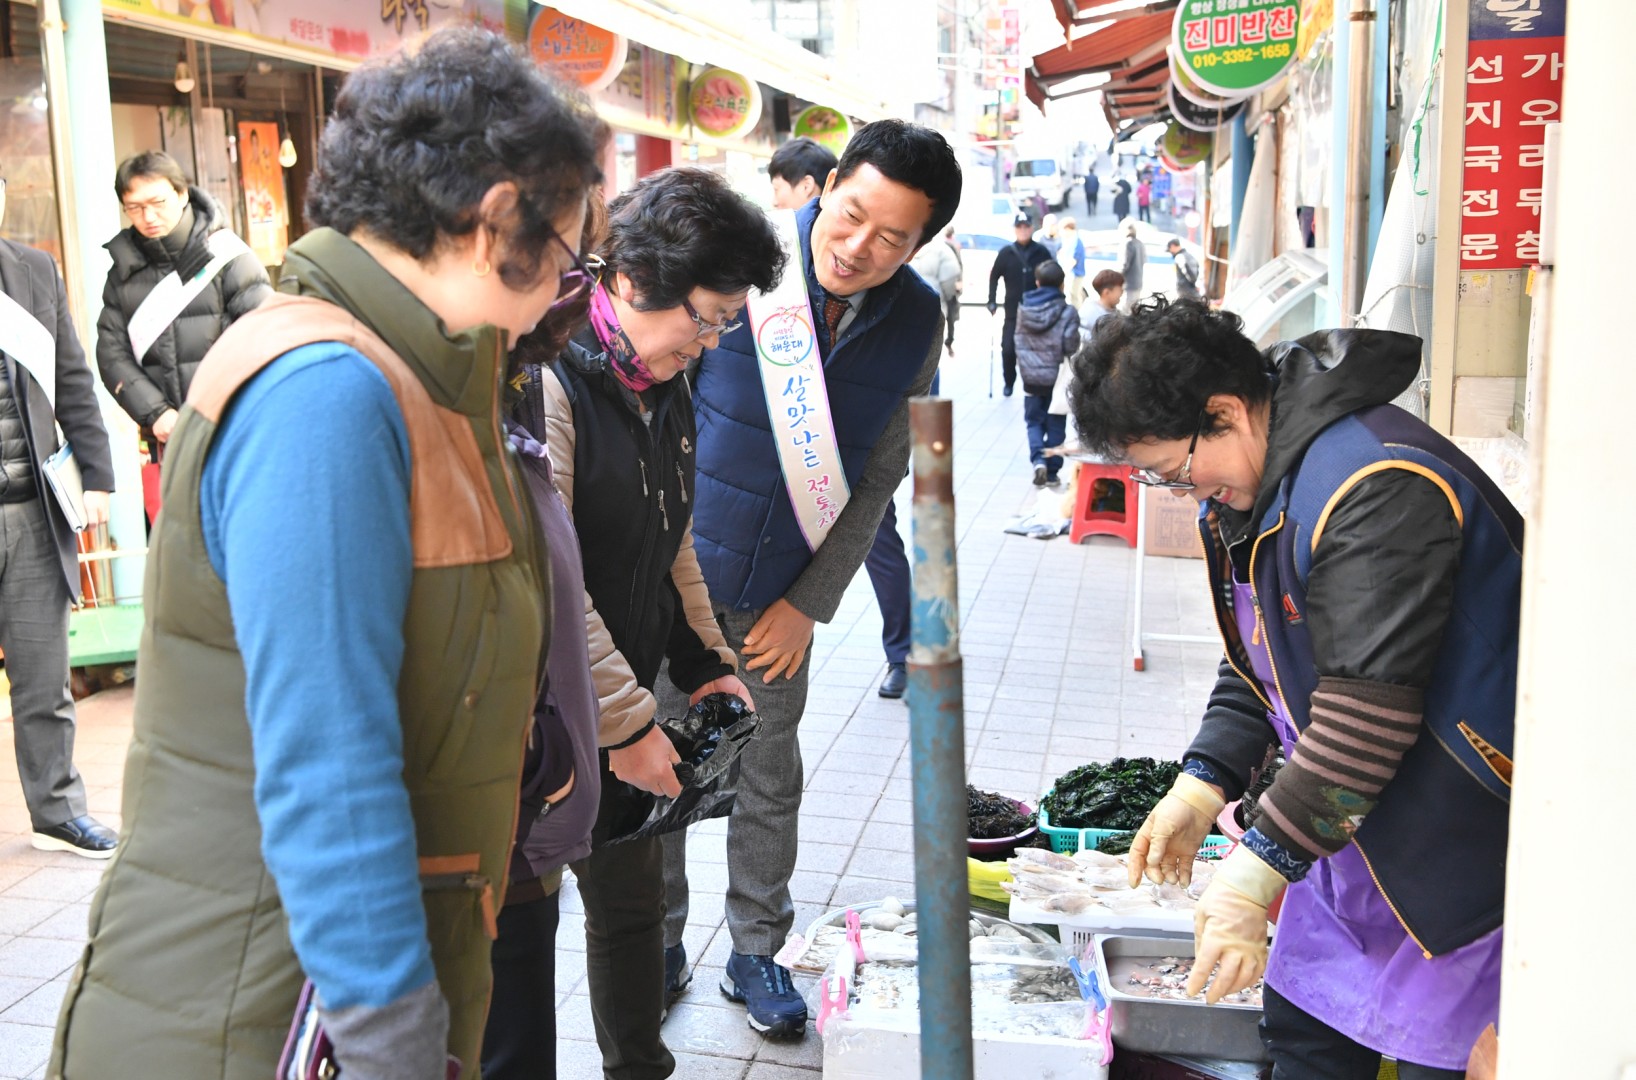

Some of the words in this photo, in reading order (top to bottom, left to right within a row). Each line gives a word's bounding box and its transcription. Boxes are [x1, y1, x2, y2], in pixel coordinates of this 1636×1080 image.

[1184, 6, 1296, 50] 진미반찬
[1193, 43, 1290, 68] 010-3392-1658
[771, 339, 803, 352] 해운대
